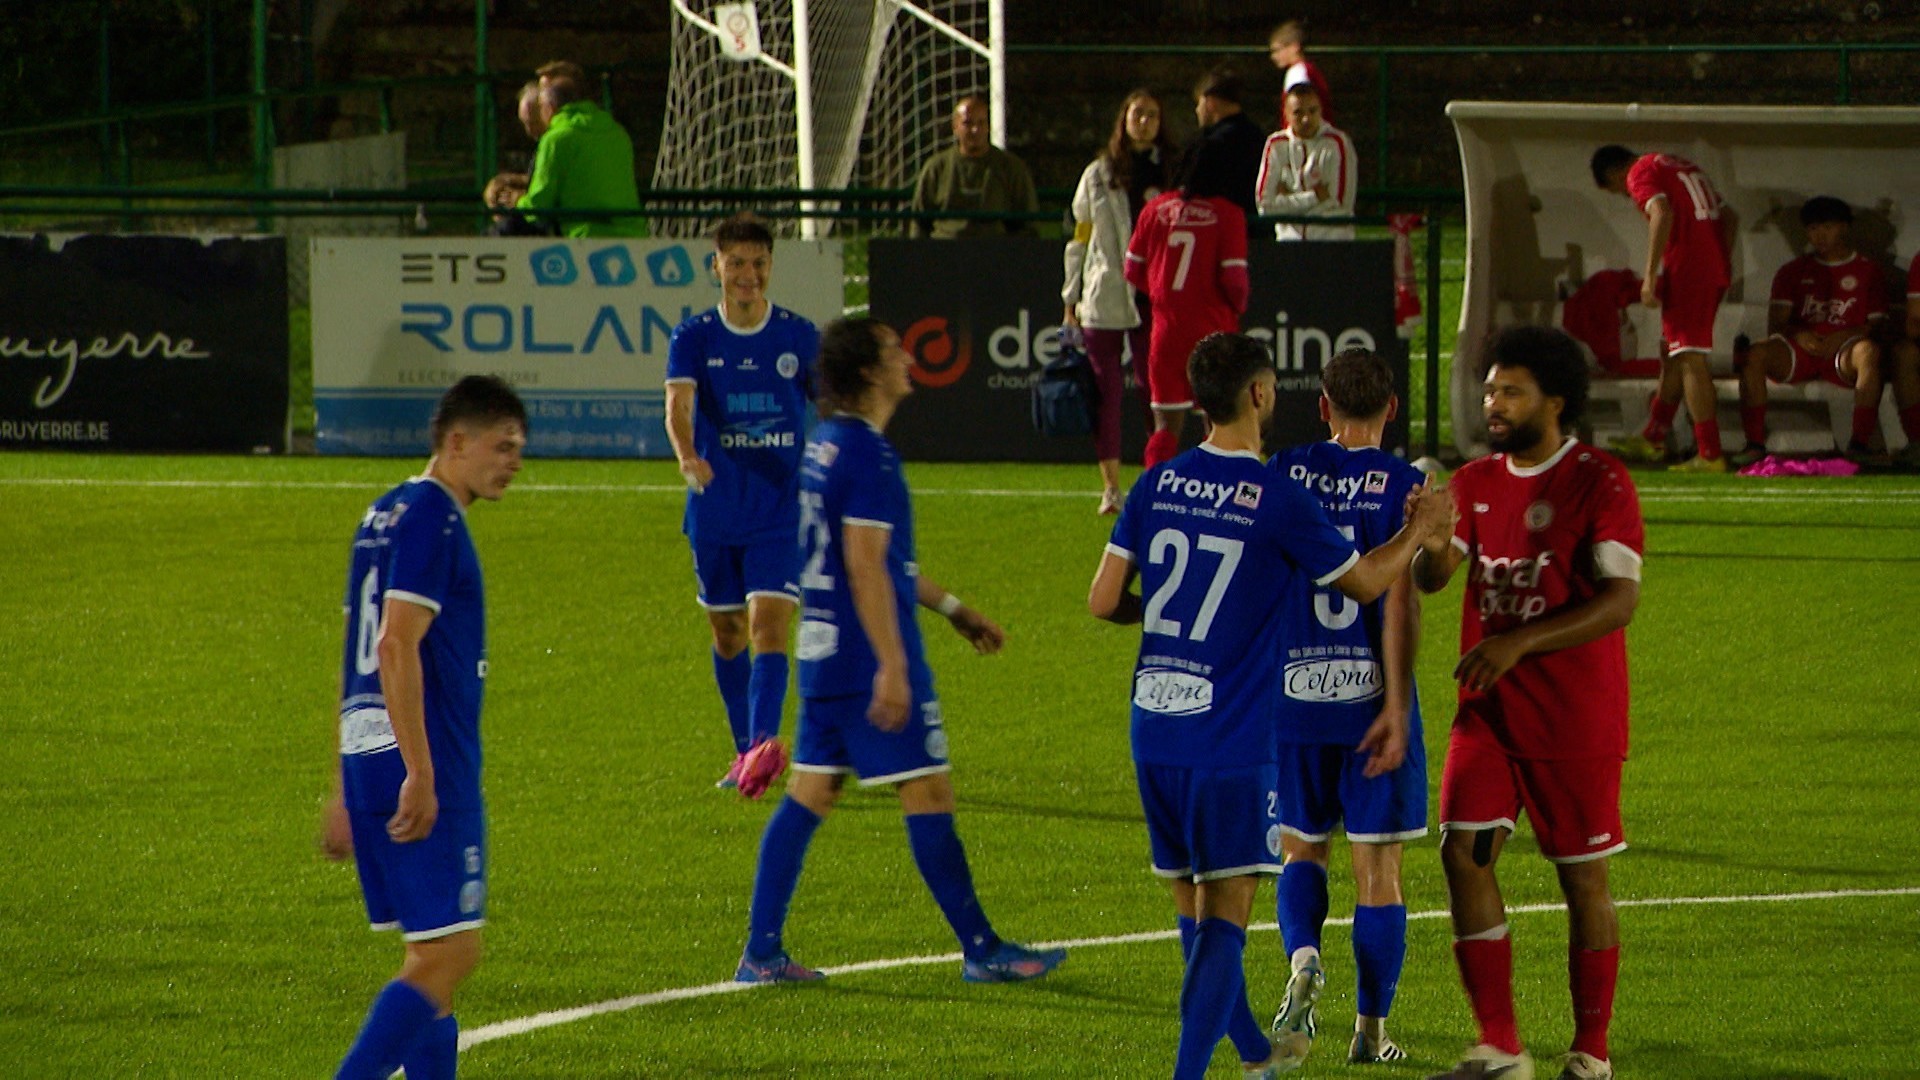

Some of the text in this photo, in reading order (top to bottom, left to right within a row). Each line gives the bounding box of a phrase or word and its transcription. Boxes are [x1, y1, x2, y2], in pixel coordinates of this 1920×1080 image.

[401, 254, 507, 284] ETS
[1167, 230, 1196, 291] 7
[401, 304, 691, 353] ROLAN
[0, 332, 210, 408] uyerre
[727, 392, 783, 413] MEL
[0, 420, 109, 440] RUYERRE.BE
[720, 432, 796, 448] DRONE
[1156, 469, 1235, 508] Proxy
[1143, 528, 1245, 642] 27
[356, 564, 380, 675] 6
[1266, 789, 1278, 818] 2
